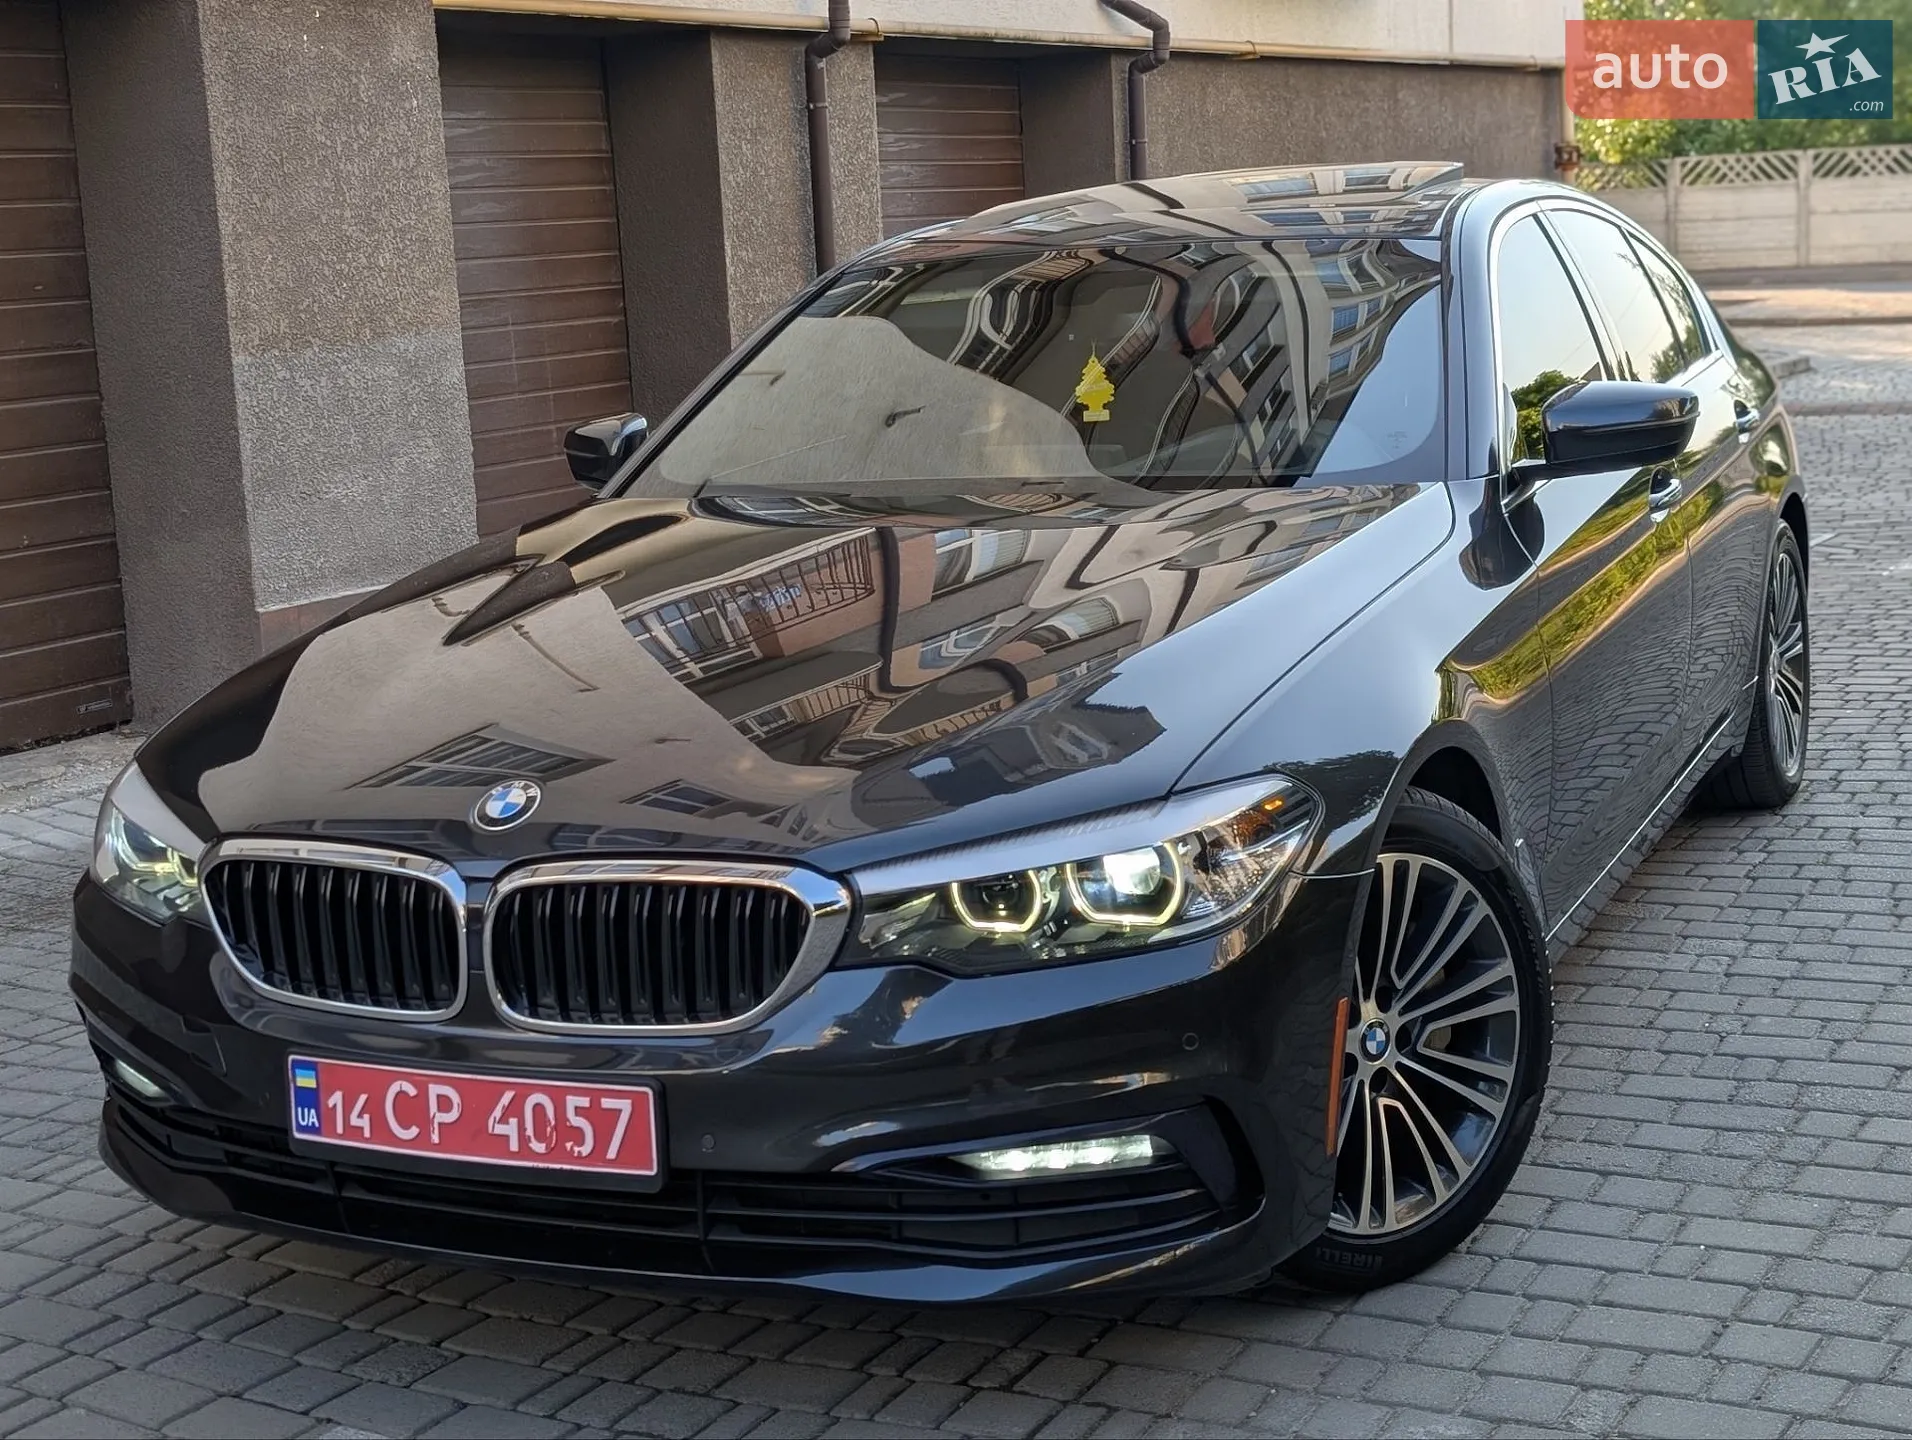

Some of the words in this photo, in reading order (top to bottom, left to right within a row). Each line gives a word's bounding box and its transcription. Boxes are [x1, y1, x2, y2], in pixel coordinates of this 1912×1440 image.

[298, 1107, 319, 1128] UA
[326, 1090, 371, 1139] 14
[384, 1080, 462, 1144] CP
[487, 1090, 633, 1160] 4057
